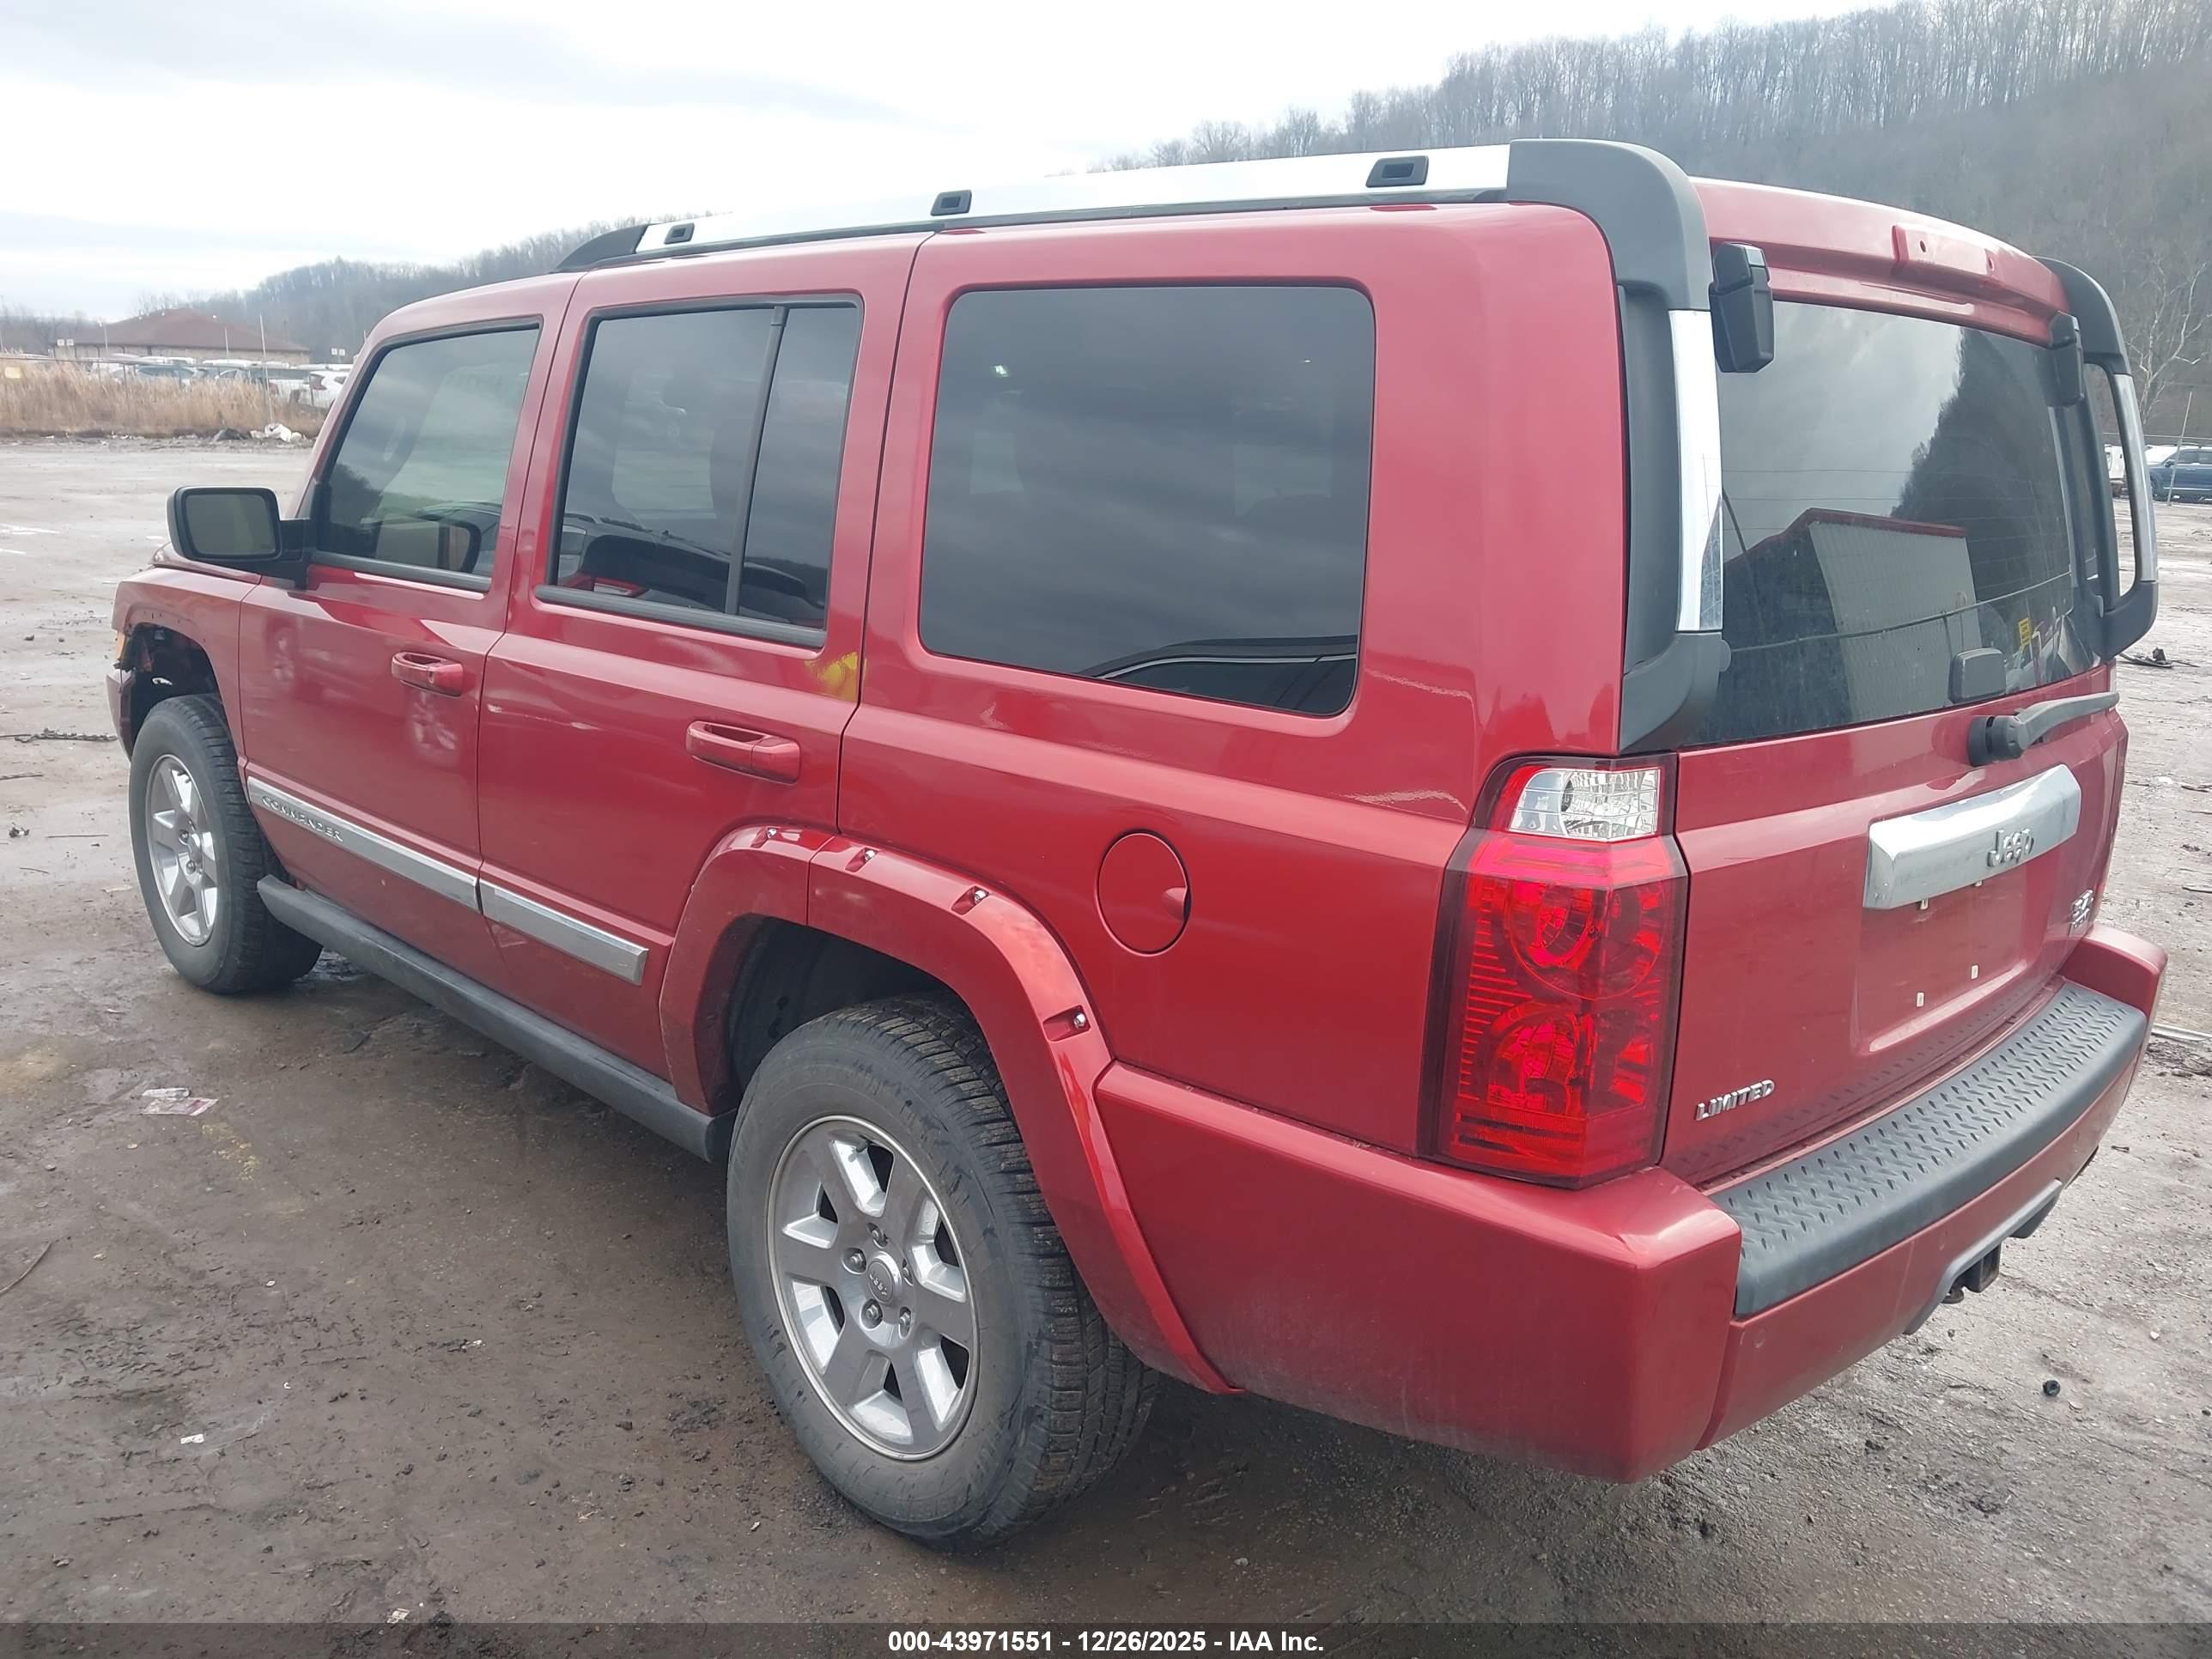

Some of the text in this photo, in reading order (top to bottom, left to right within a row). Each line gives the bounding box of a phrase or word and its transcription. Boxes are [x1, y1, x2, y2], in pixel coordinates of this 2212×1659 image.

[262, 795, 343, 842] COMMANDER
[1986, 829, 2035, 867] Jeep
[1695, 1079, 1775, 1121] LIMITED
